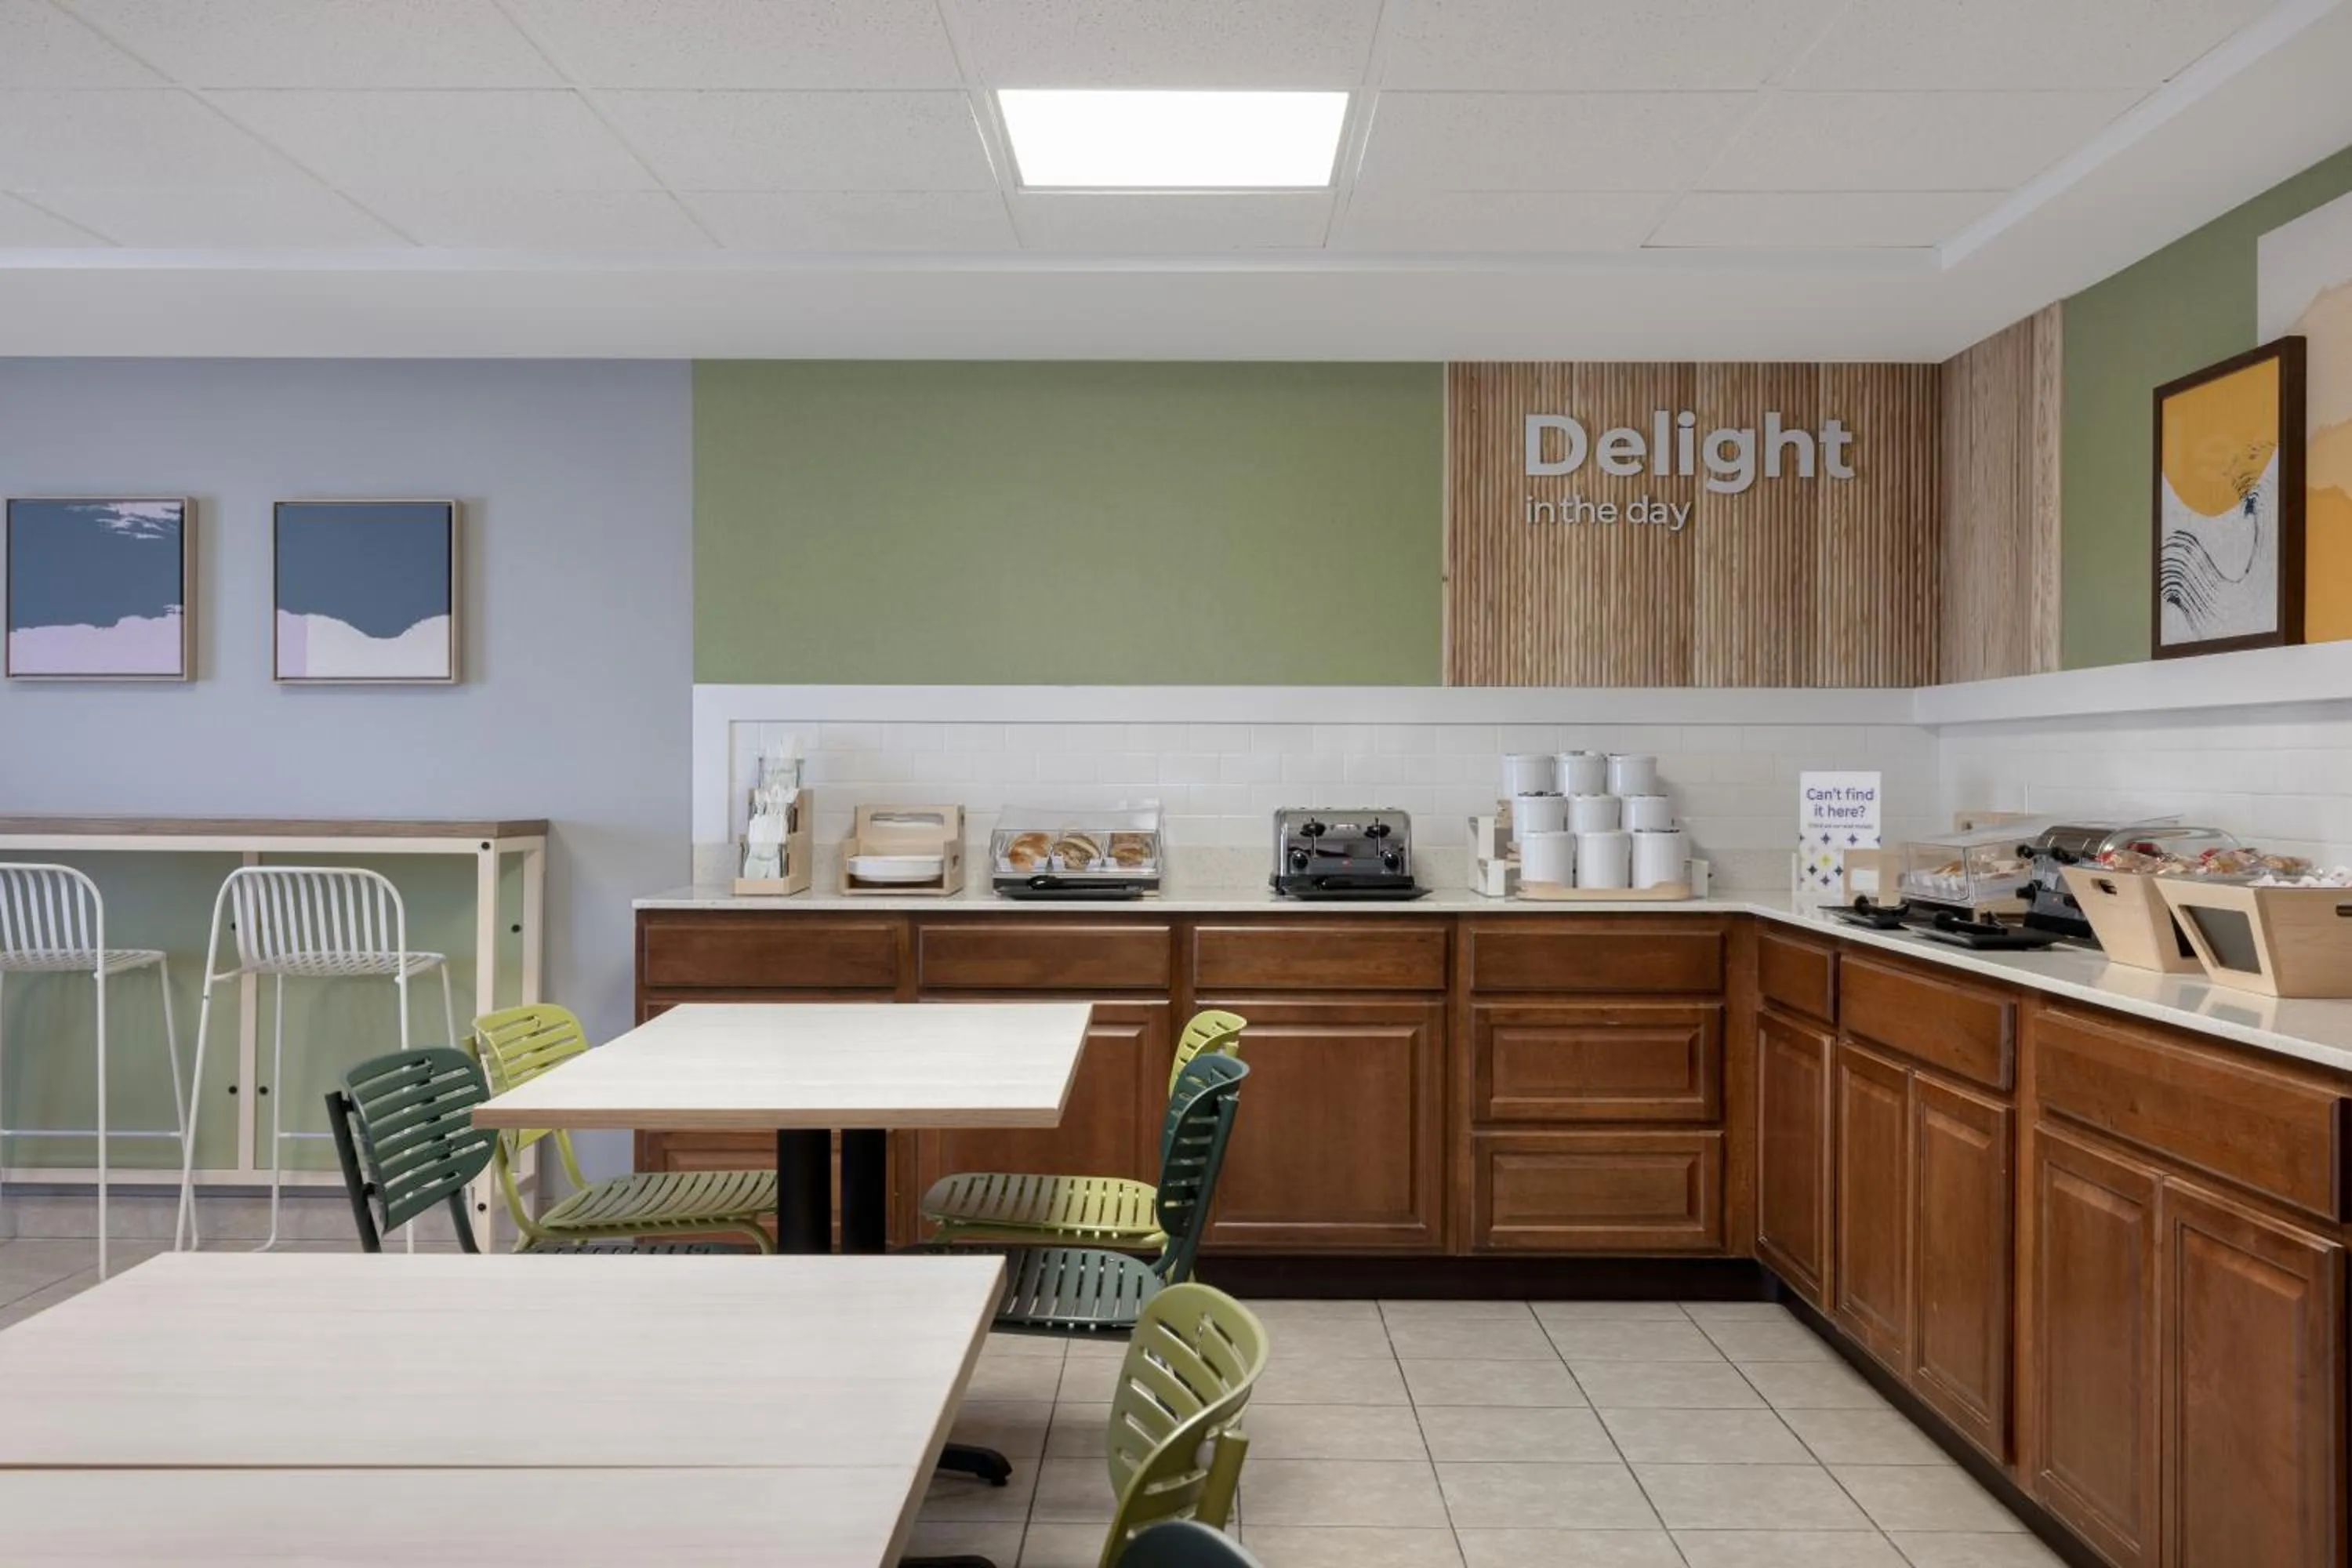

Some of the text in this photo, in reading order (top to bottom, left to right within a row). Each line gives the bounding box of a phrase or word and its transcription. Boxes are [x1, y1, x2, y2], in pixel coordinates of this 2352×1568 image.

[1524, 409, 1856, 493] Delight
[1626, 495, 1691, 531] day
[1806, 788, 1875, 800] Can't find
[1814, 804, 1866, 818] it here?
